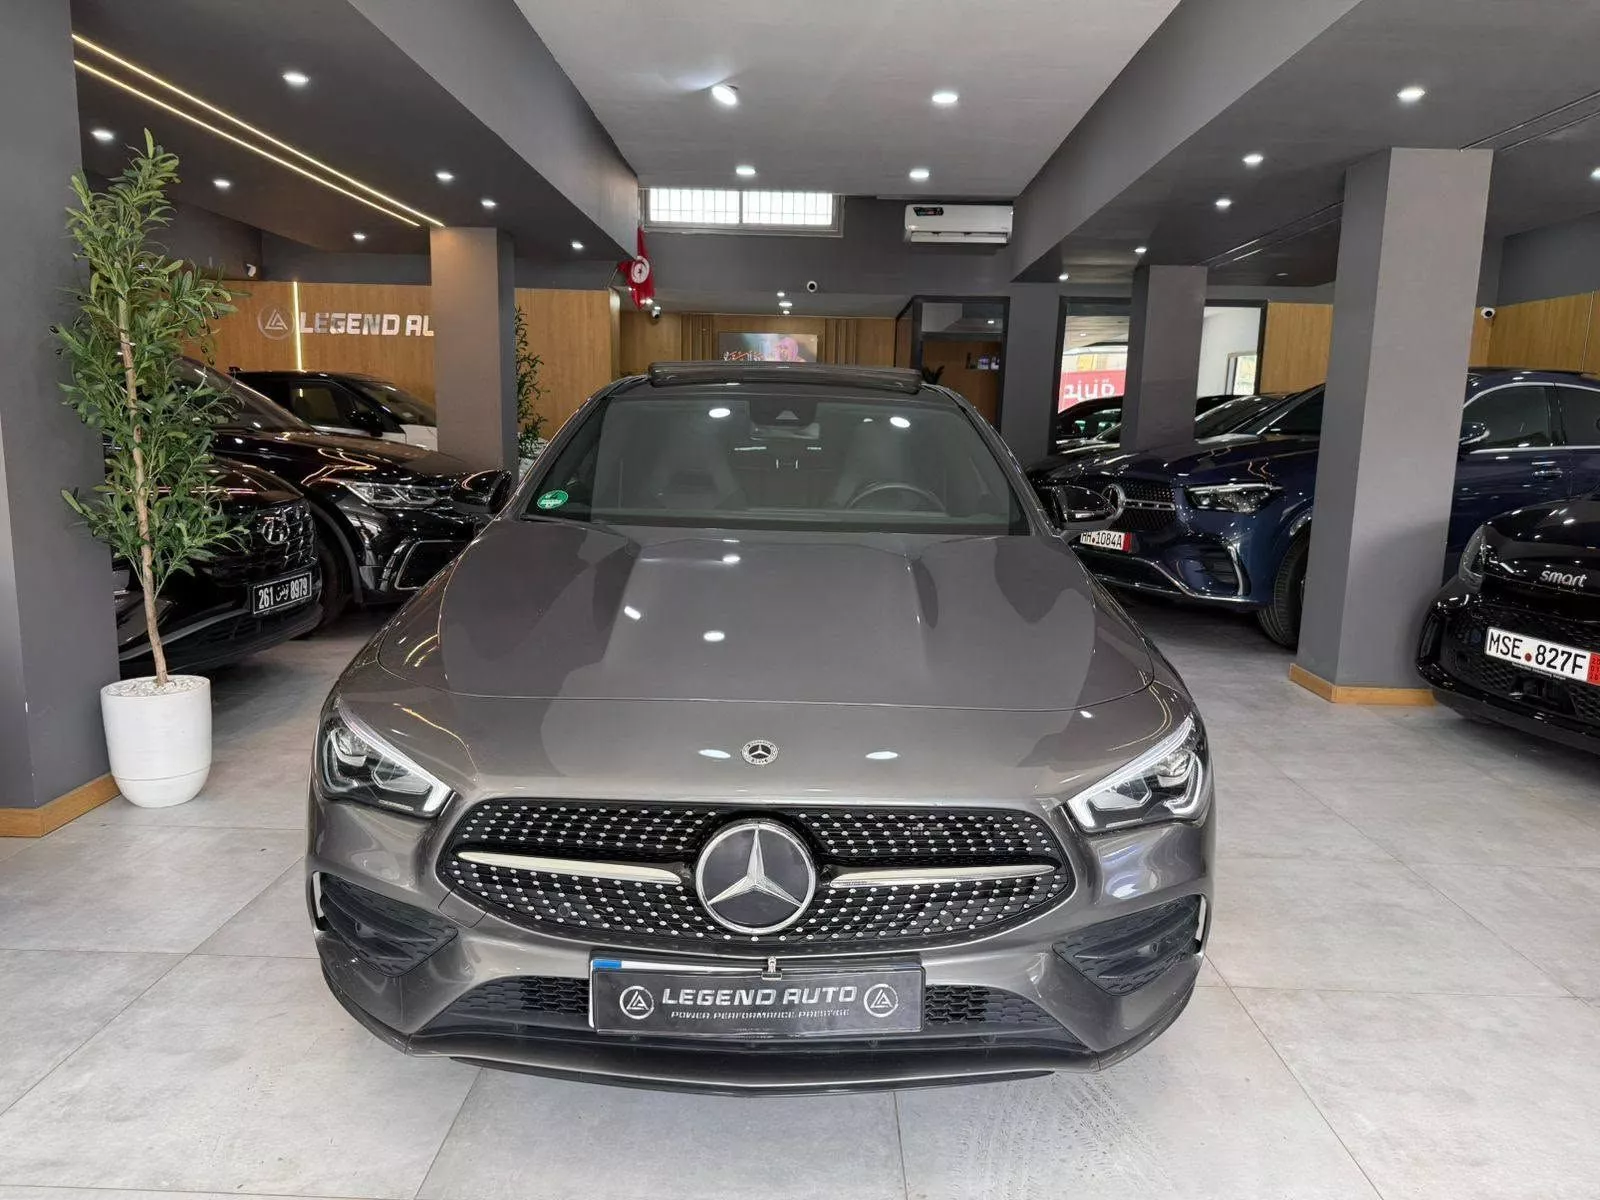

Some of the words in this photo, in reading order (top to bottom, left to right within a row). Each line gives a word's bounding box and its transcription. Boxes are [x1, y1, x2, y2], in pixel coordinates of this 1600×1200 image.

[300, 311, 401, 336] LEGEND
[405, 314, 435, 337] AU
[1095, 532, 1122, 548] 1084A
[1540, 570, 1588, 588] smart
[259, 586, 274, 609] 261
[275, 584, 289, 601] تونس
[290, 577, 307, 600] 8979
[1488, 631, 1524, 660] MSE
[1535, 644, 1587, 675] 827F
[662, 988, 777, 1005] LEGEND
[782, 986, 858, 1005] AUTO
[670, 1011, 711, 1020] POWER
